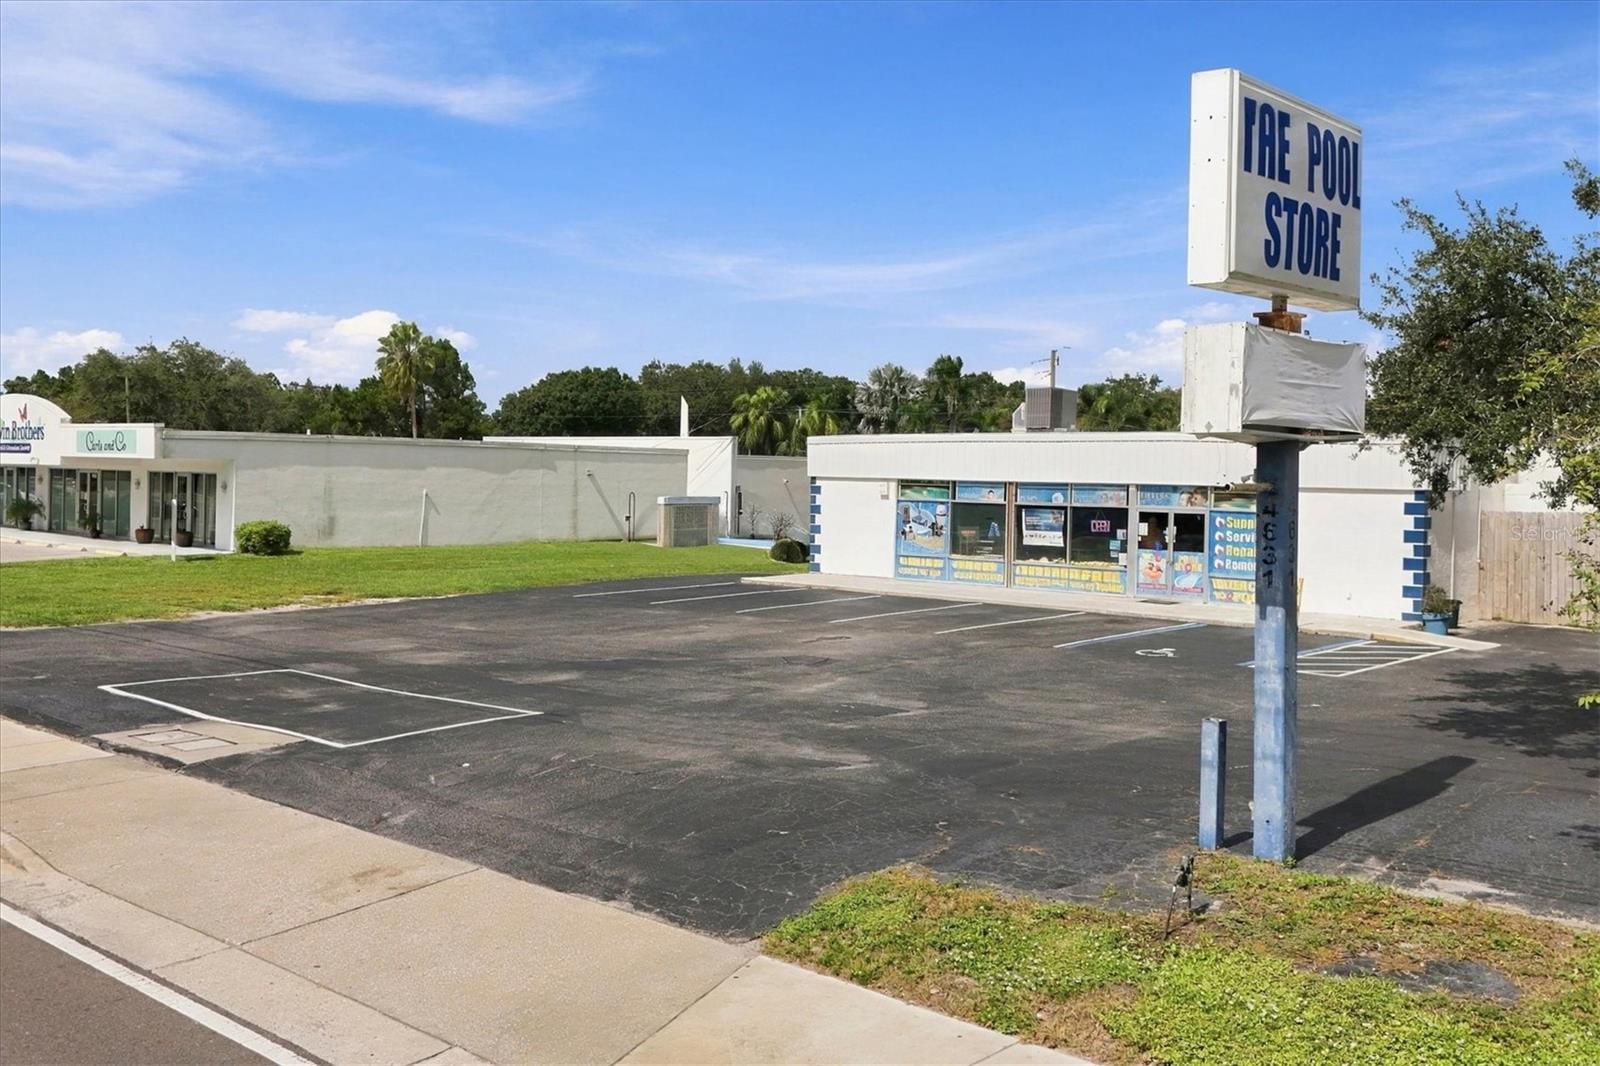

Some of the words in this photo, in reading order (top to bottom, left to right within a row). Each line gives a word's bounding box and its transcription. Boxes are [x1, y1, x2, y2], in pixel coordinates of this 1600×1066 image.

[1307, 122, 1361, 210] POOL
[1264, 191, 1342, 282] STORE
[115, 431, 127, 452] Co
[1226, 531, 1257, 543] Servi
[1226, 545, 1257, 558] Repai
[1225, 559, 1257, 571] Remo
